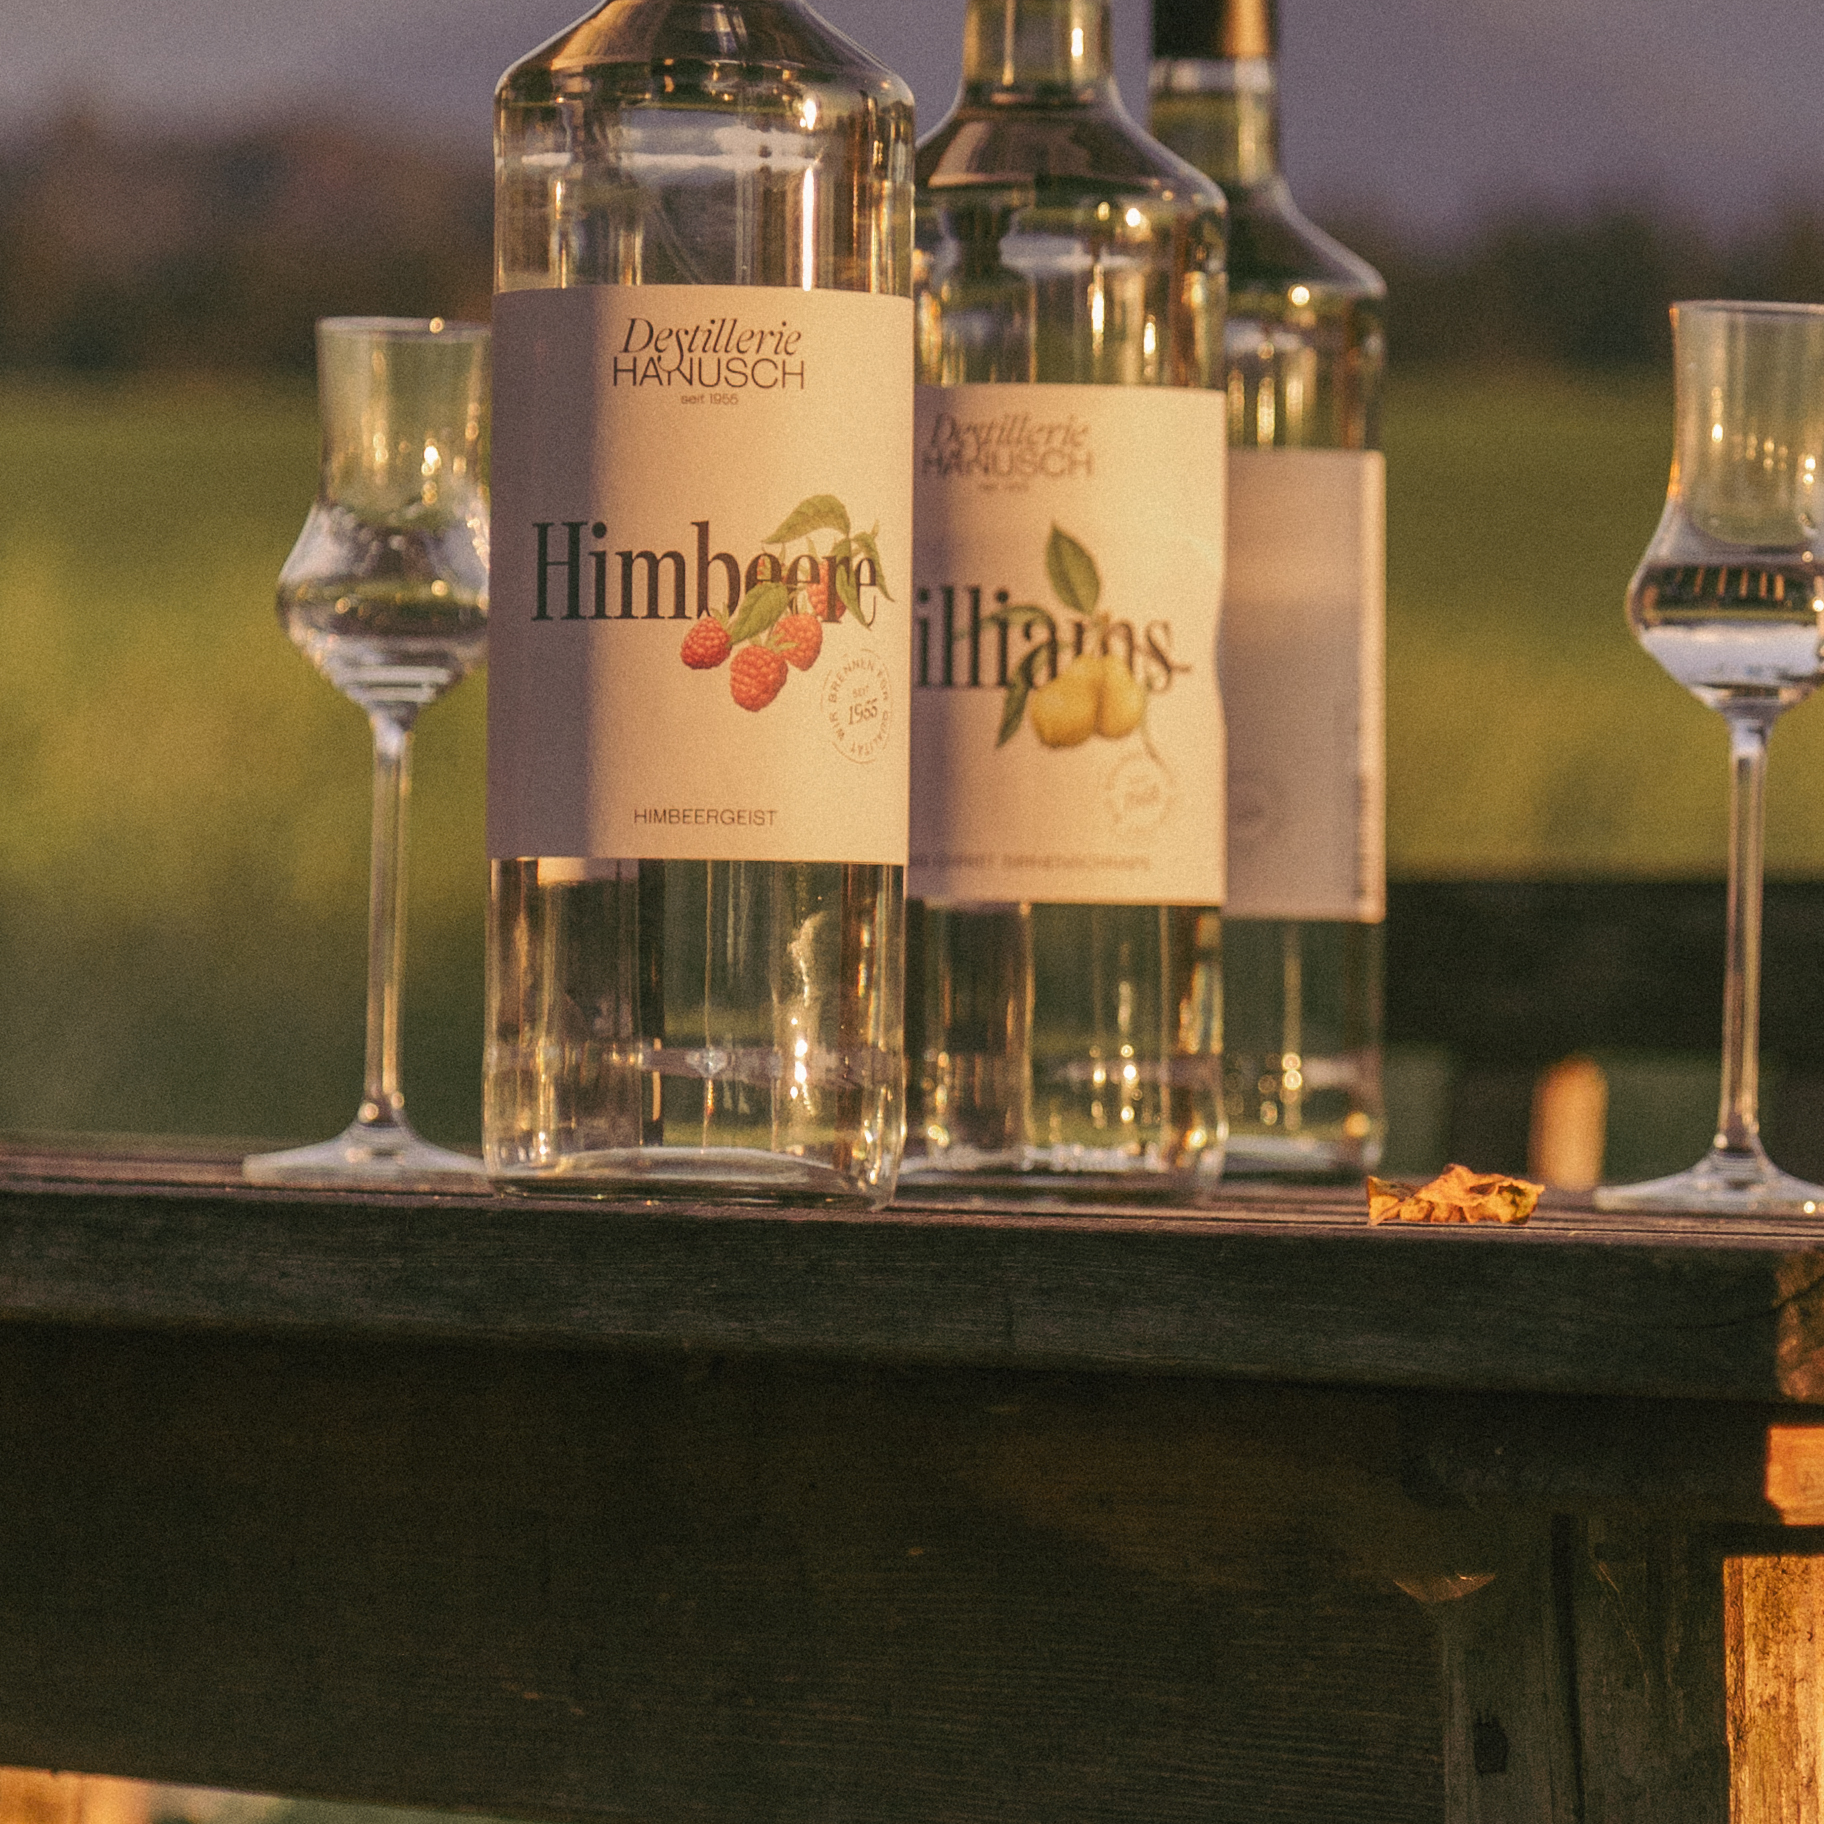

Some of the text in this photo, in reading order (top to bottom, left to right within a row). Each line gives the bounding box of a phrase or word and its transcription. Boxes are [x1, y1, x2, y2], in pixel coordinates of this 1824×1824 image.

[612, 354, 806, 390] HANUSCH
[618, 316, 803, 372] Destillerie
[531, 518, 878, 627] Himbeere
[912, 583, 1193, 695] illiams
[633, 807, 779, 827] HIMBEERGEIST
